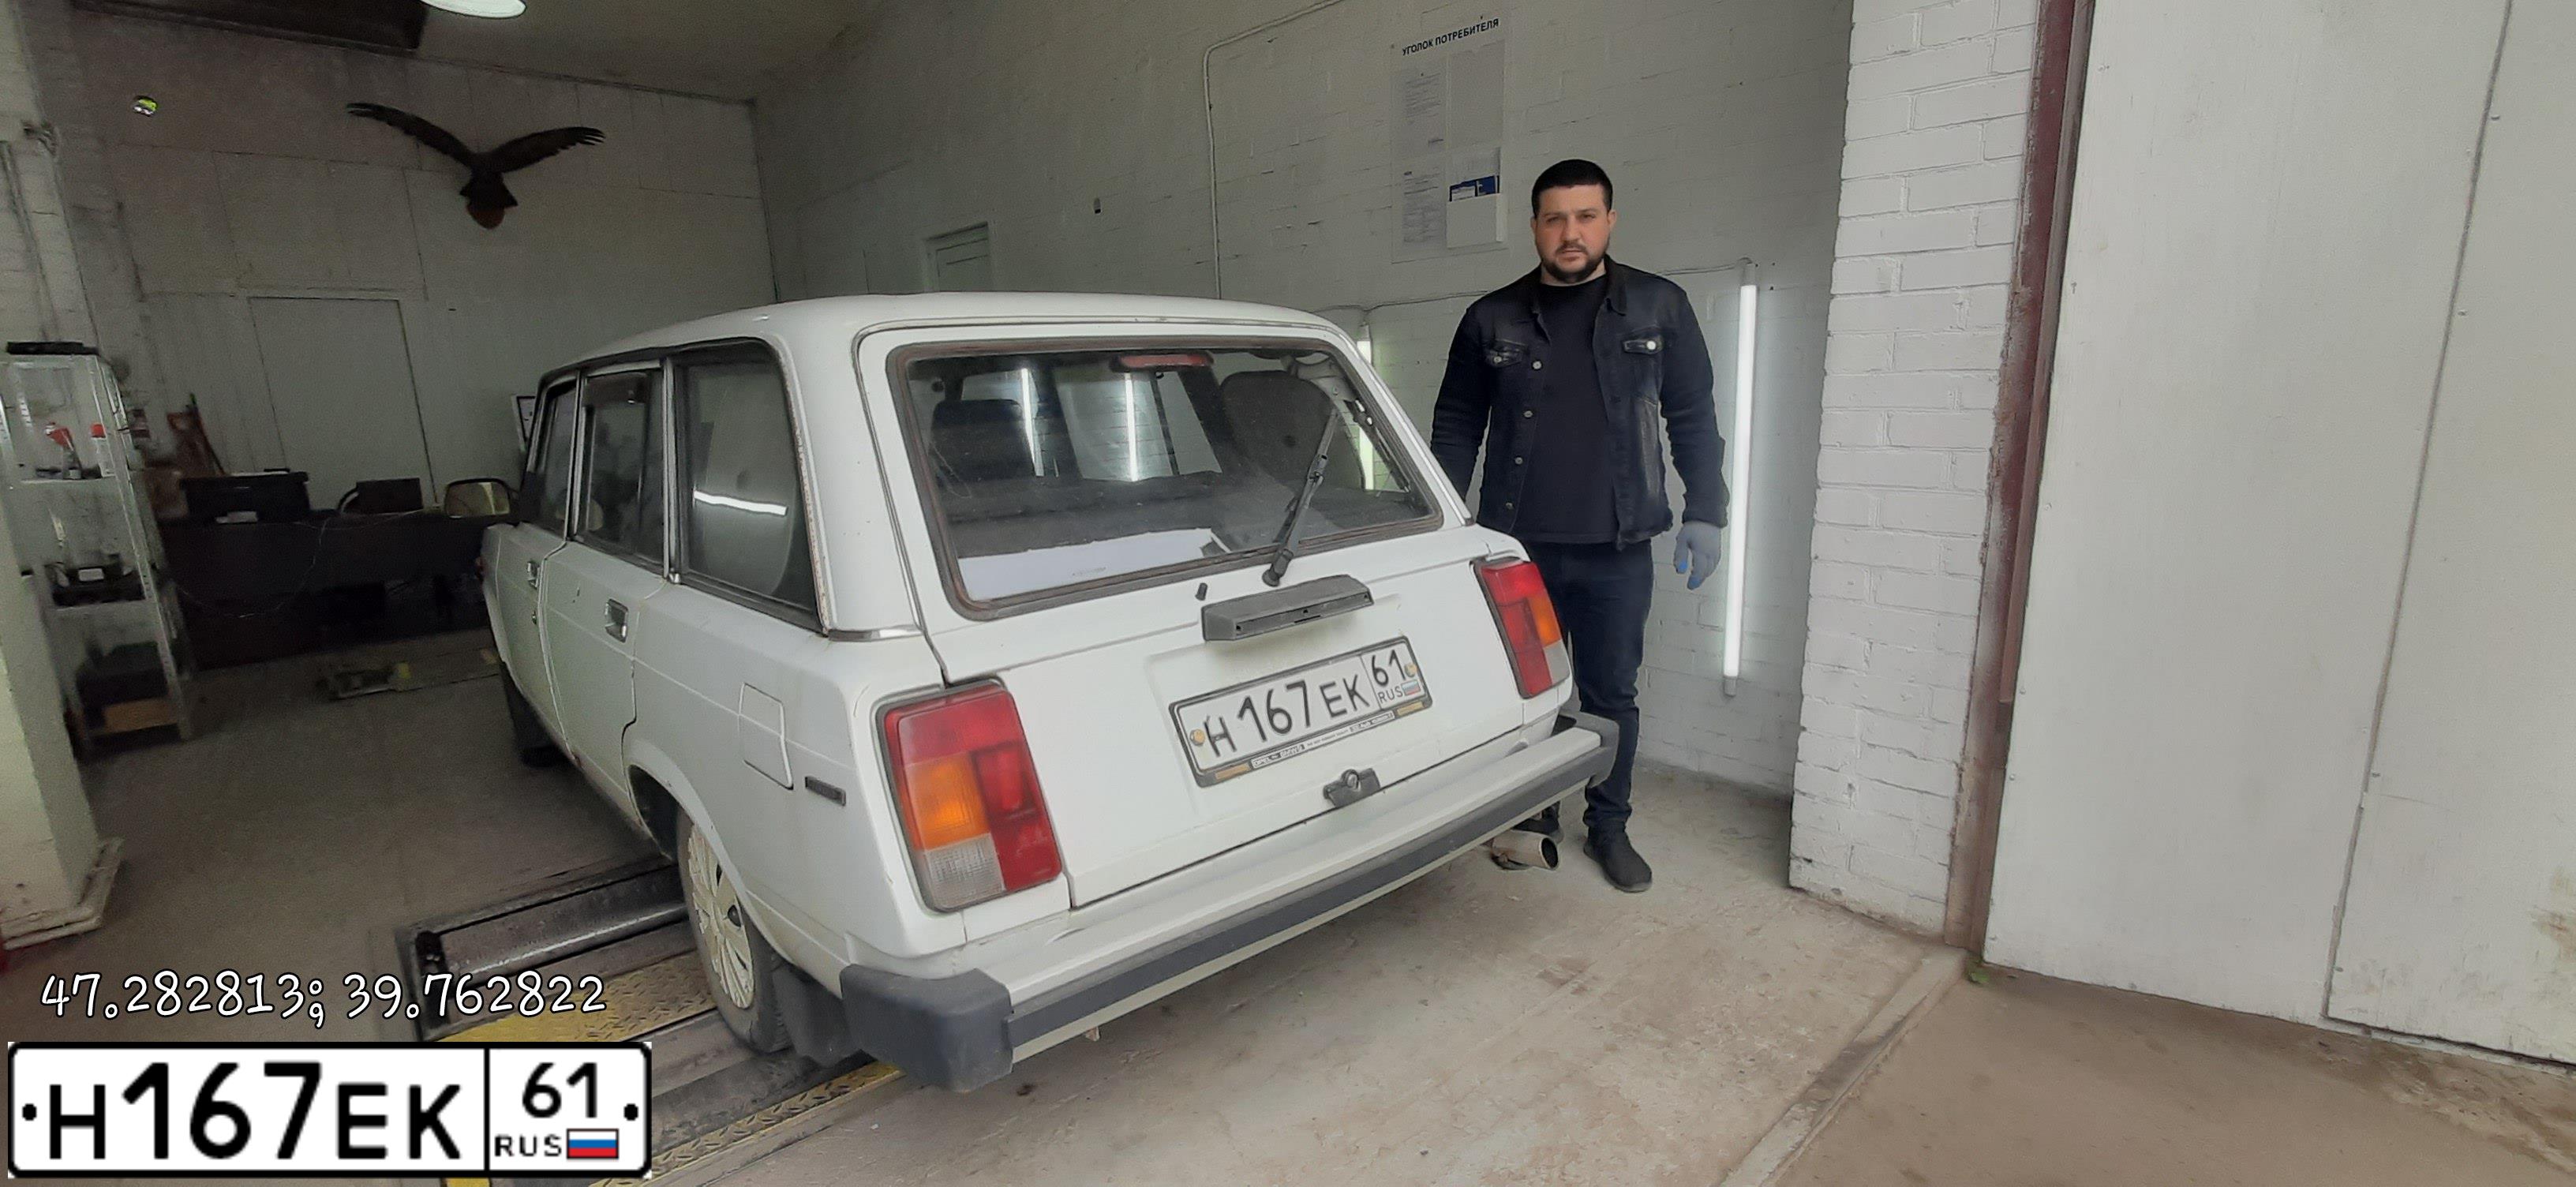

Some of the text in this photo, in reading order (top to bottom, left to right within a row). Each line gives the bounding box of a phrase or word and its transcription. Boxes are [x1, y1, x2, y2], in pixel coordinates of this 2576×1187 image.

[1402, 18, 1499, 55] УГОЛОК ПОТРЕБИТЕЛЯ
[1372, 649, 1406, 687] 61
[1377, 686, 1403, 704] RUS
